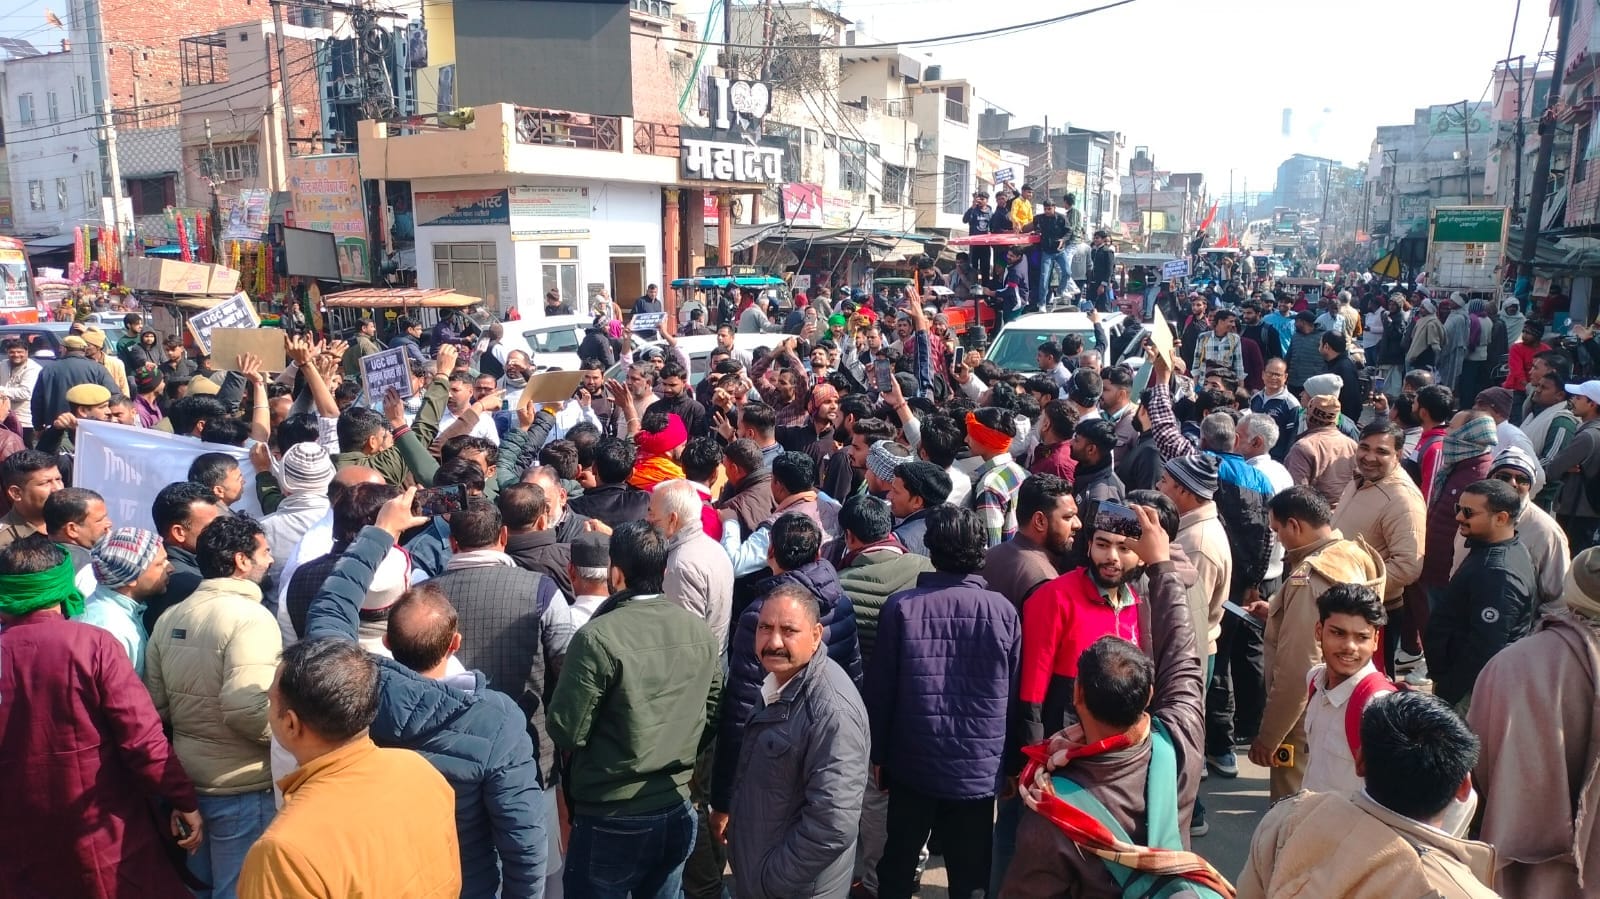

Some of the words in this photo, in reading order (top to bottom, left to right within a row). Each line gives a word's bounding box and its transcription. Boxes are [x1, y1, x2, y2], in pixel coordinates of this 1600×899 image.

[715, 78, 730, 129] I
[682, 133, 785, 183] महादेव
[476, 193, 503, 209] पोस्ट
[202, 310, 224, 325] UGC
[370, 357, 386, 370] UGC
